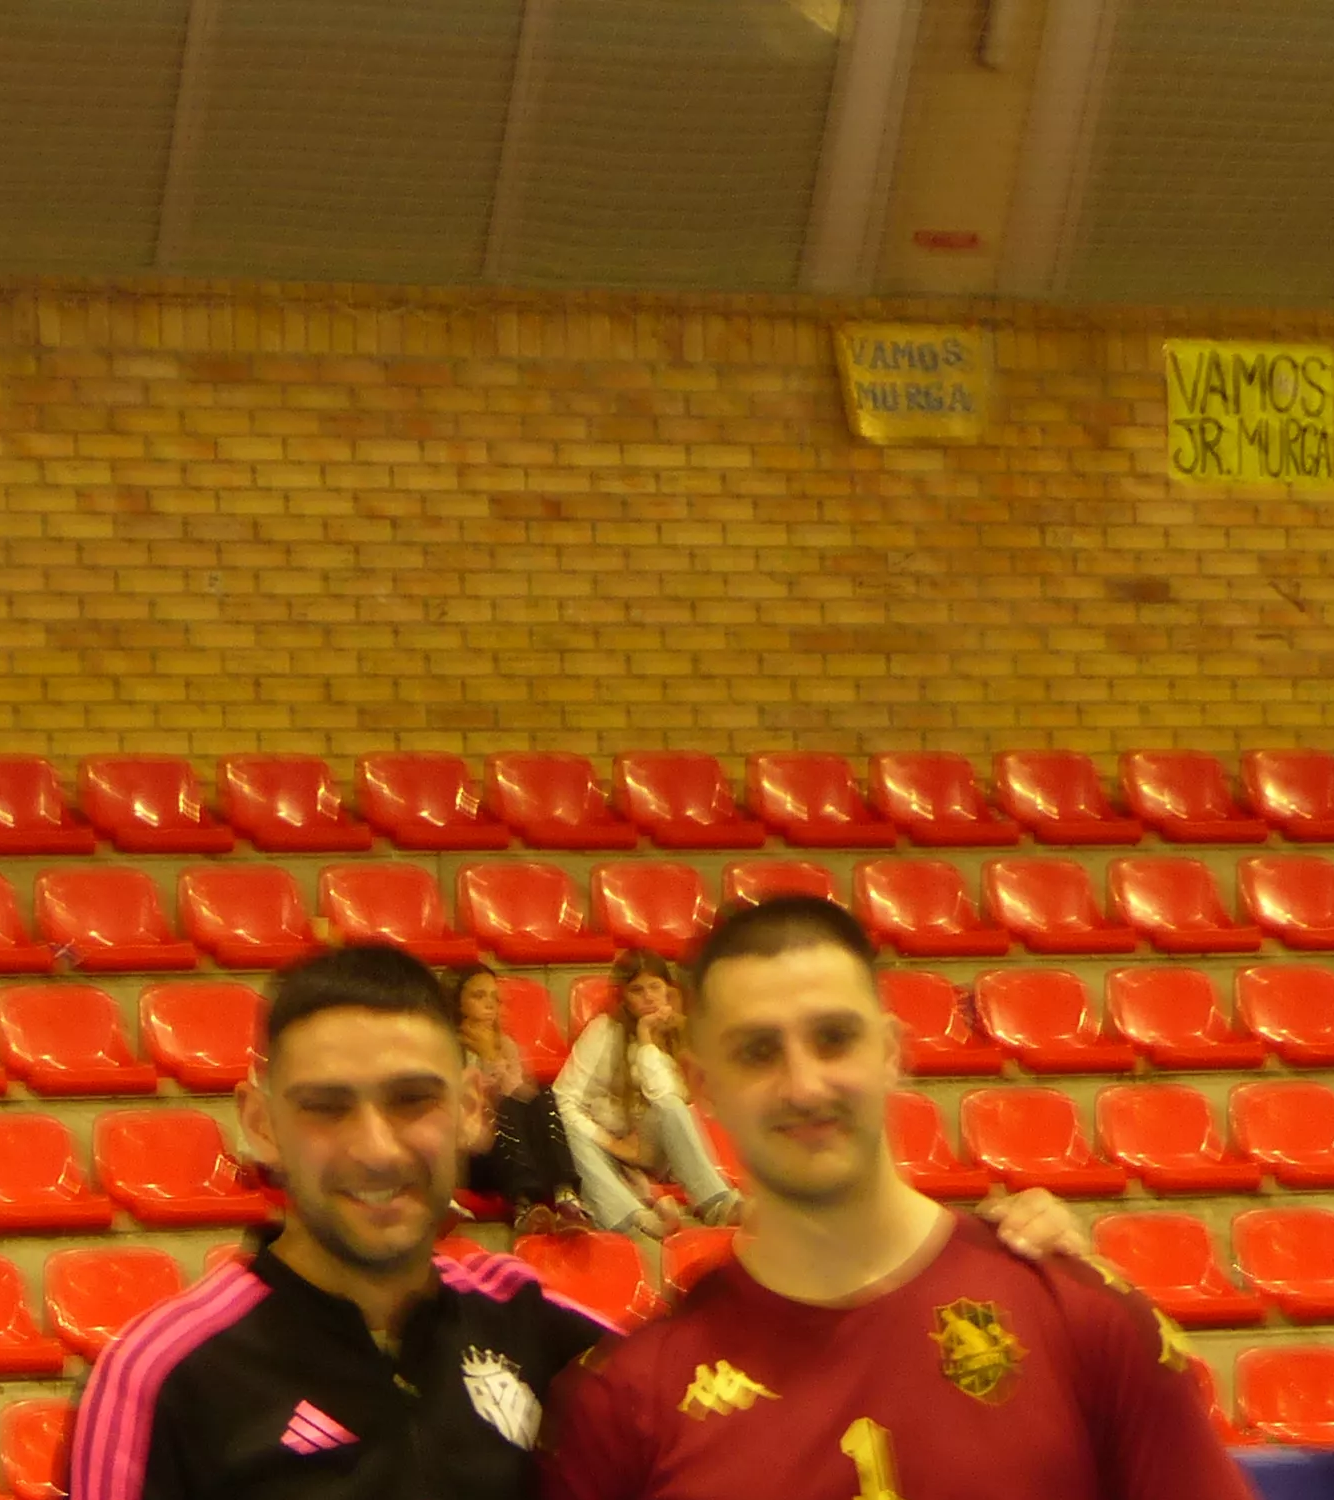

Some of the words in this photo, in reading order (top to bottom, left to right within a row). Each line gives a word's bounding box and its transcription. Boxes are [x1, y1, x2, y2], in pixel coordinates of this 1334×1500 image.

[849, 337, 965, 372] VAMOS
[853, 382, 974, 413] MURGA
[1169, 350, 1327, 418] VAMOS
[1171, 418, 1231, 476] JR.
[1237, 416, 1334, 479] MURGA
